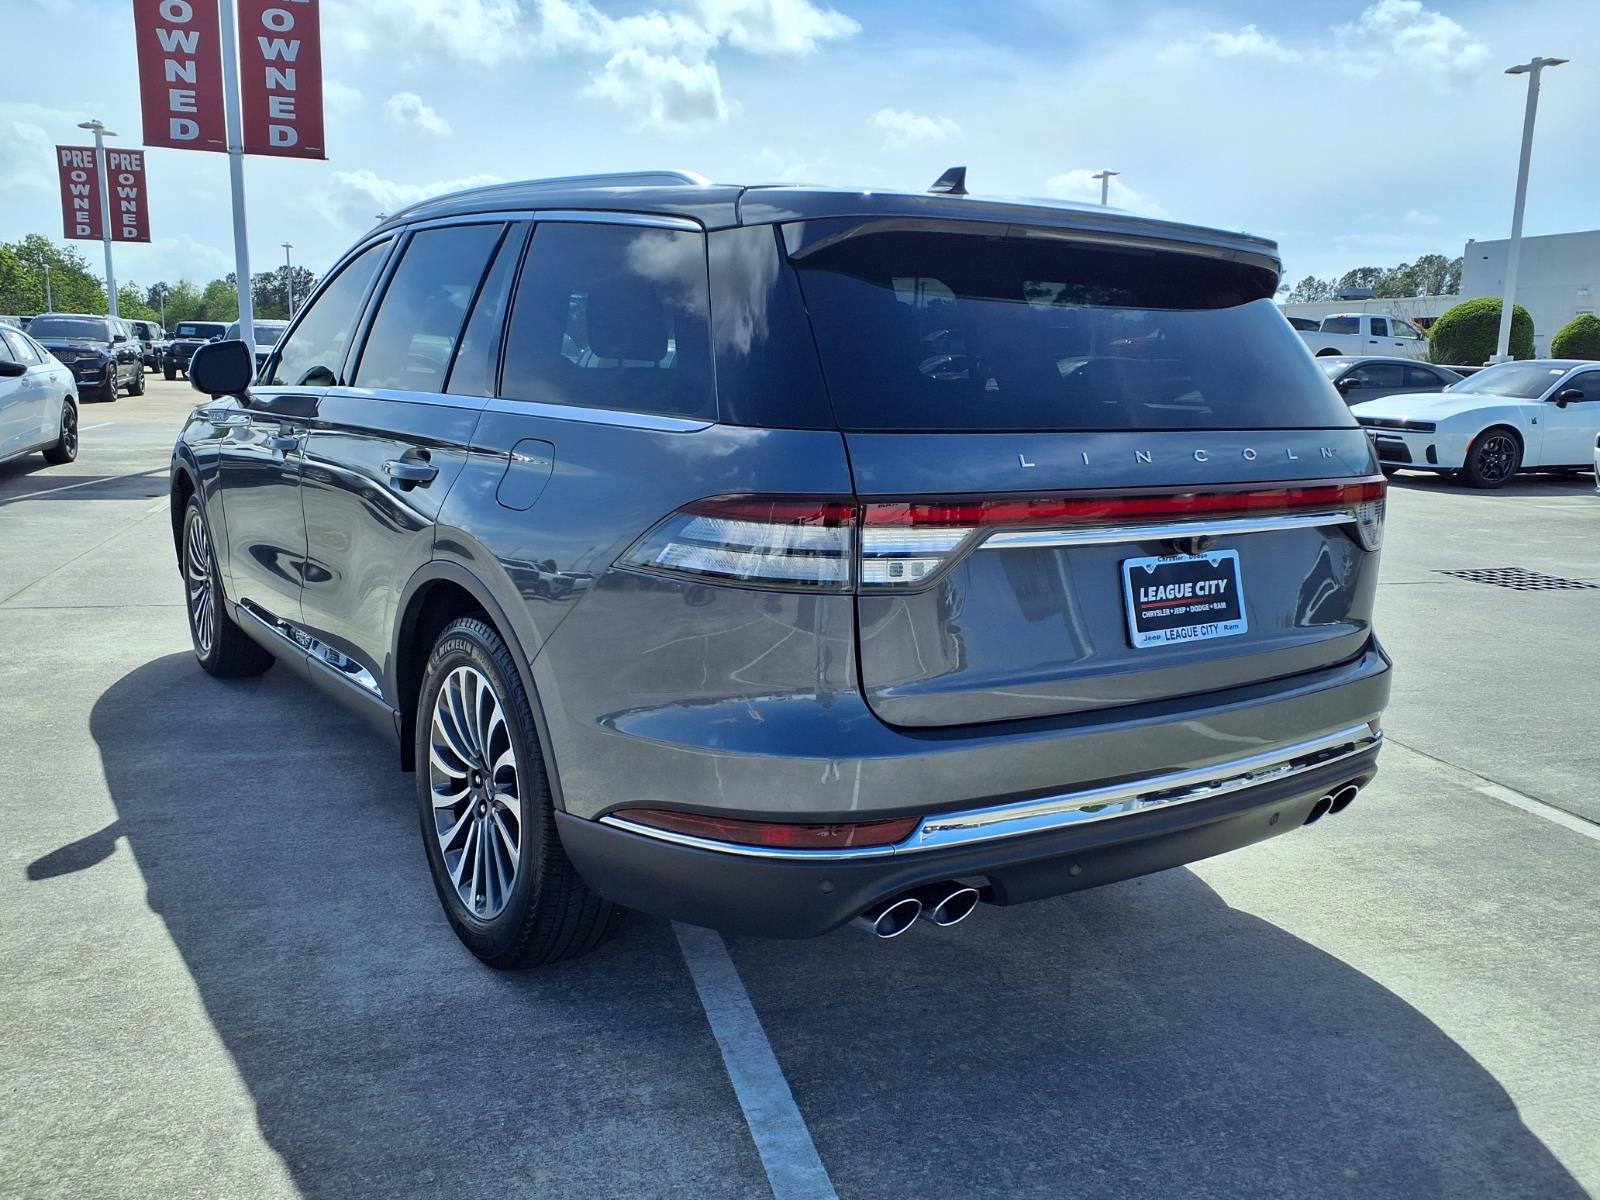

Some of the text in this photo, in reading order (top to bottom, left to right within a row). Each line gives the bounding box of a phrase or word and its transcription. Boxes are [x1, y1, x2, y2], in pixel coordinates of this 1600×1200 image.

[155, 0, 200, 141] OWNED
[257, 8, 301, 148] OWNED
[61, 150, 93, 168] PRE
[109, 153, 141, 171] PRE
[69, 170, 91, 236] OWNED
[117, 173, 138, 238] OWNED
[1019, 447, 1335, 467] LINCOLN
[1140, 579, 1228, 602] LEAGUE CITY
[1190, 605, 1209, 613] DODGE
[1143, 634, 1161, 642] Jeep
[1164, 626, 1198, 641] LEAGUE
[1200, 624, 1219, 636] CITY
[439, 640, 473, 657] MICHELIN
